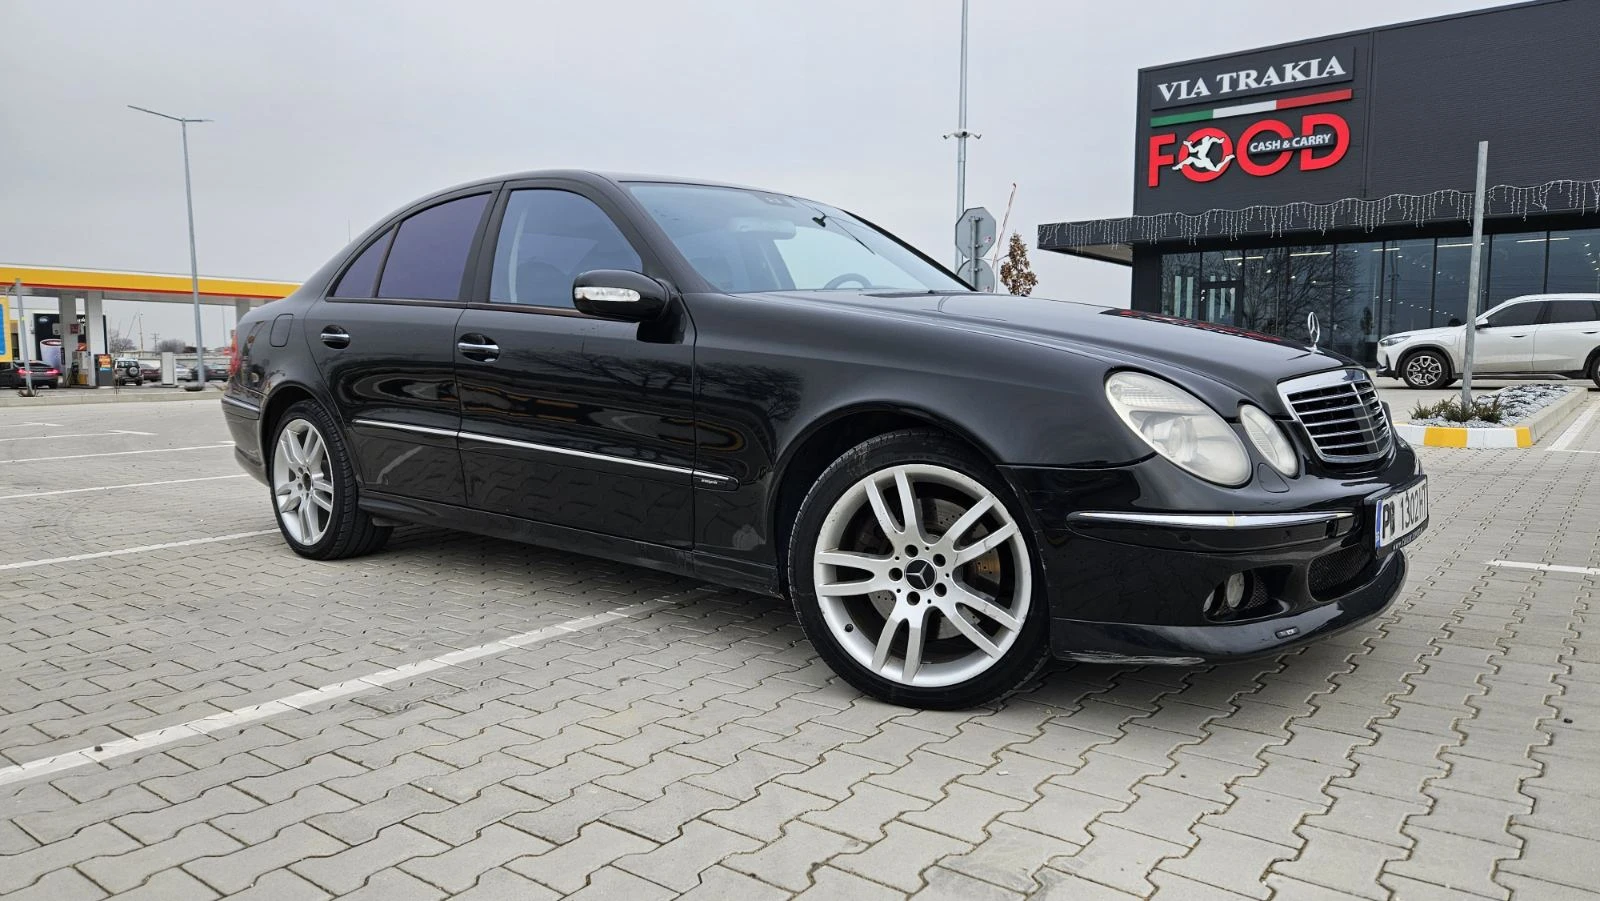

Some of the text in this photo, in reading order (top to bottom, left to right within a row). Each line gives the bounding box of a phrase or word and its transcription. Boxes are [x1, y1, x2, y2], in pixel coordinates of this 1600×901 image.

[1157, 56, 1346, 101] VIA TRAKIA
[1148, 113, 1350, 187] FOOD
[1250, 133, 1332, 152] CASH & CARRY
